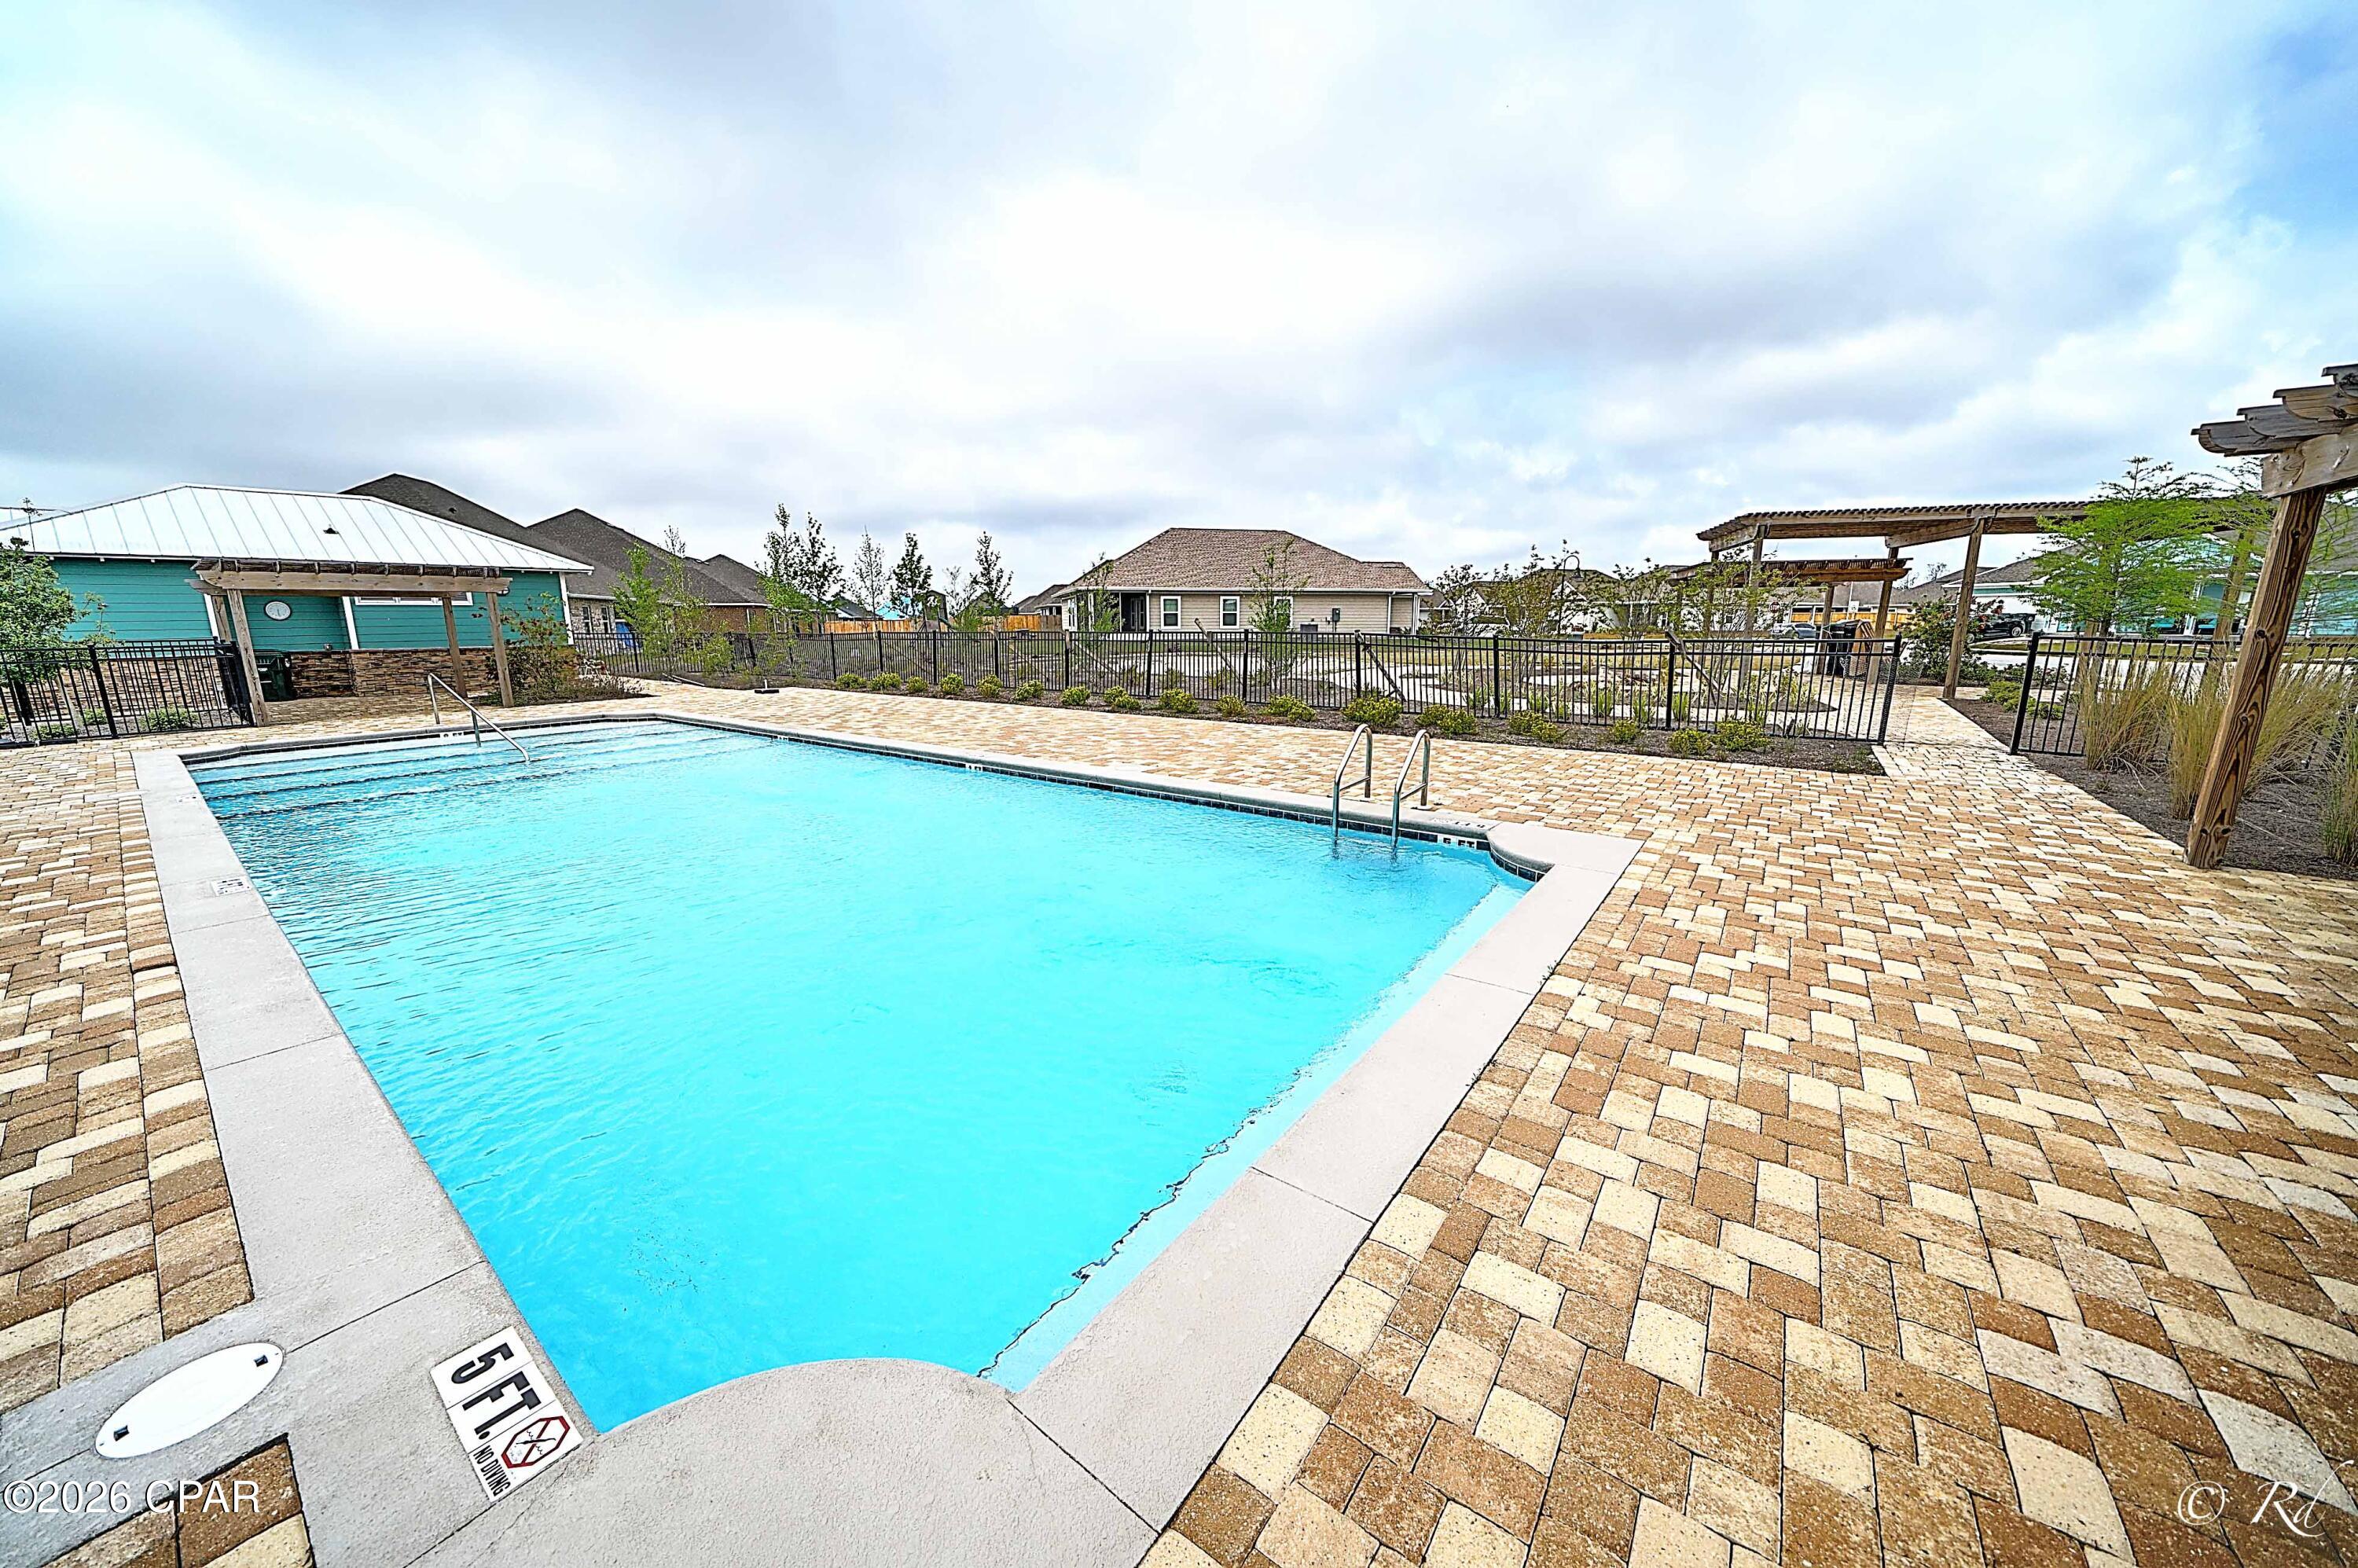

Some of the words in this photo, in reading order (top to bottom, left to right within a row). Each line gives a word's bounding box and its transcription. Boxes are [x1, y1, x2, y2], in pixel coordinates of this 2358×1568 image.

[451, 1342, 515, 1384] 5
[462, 1371, 542, 1440] FT.
[473, 1445, 494, 1465] NO
[480, 1458, 511, 1496] DIVING
